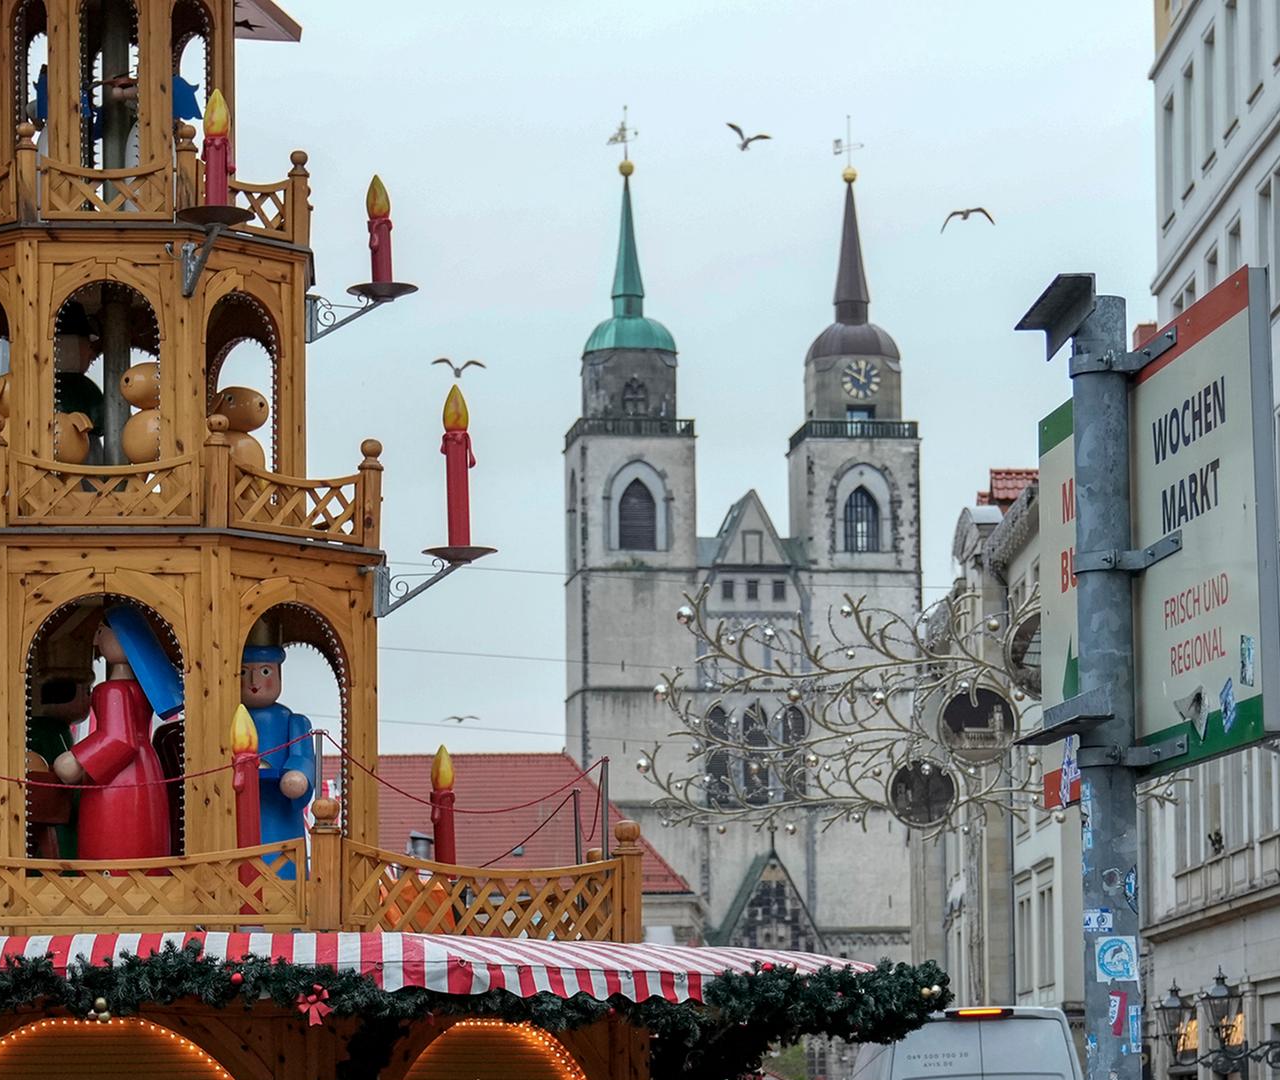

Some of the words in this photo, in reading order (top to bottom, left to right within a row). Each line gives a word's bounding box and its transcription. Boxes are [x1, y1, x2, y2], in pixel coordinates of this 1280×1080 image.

[1152, 376, 1226, 465] WOCHEN
[1161, 457, 1220, 535] MARKT
[1164, 593, 1201, 631] FRISCH
[1203, 572, 1229, 613] UND
[1170, 627, 1226, 677] REGIONAL
